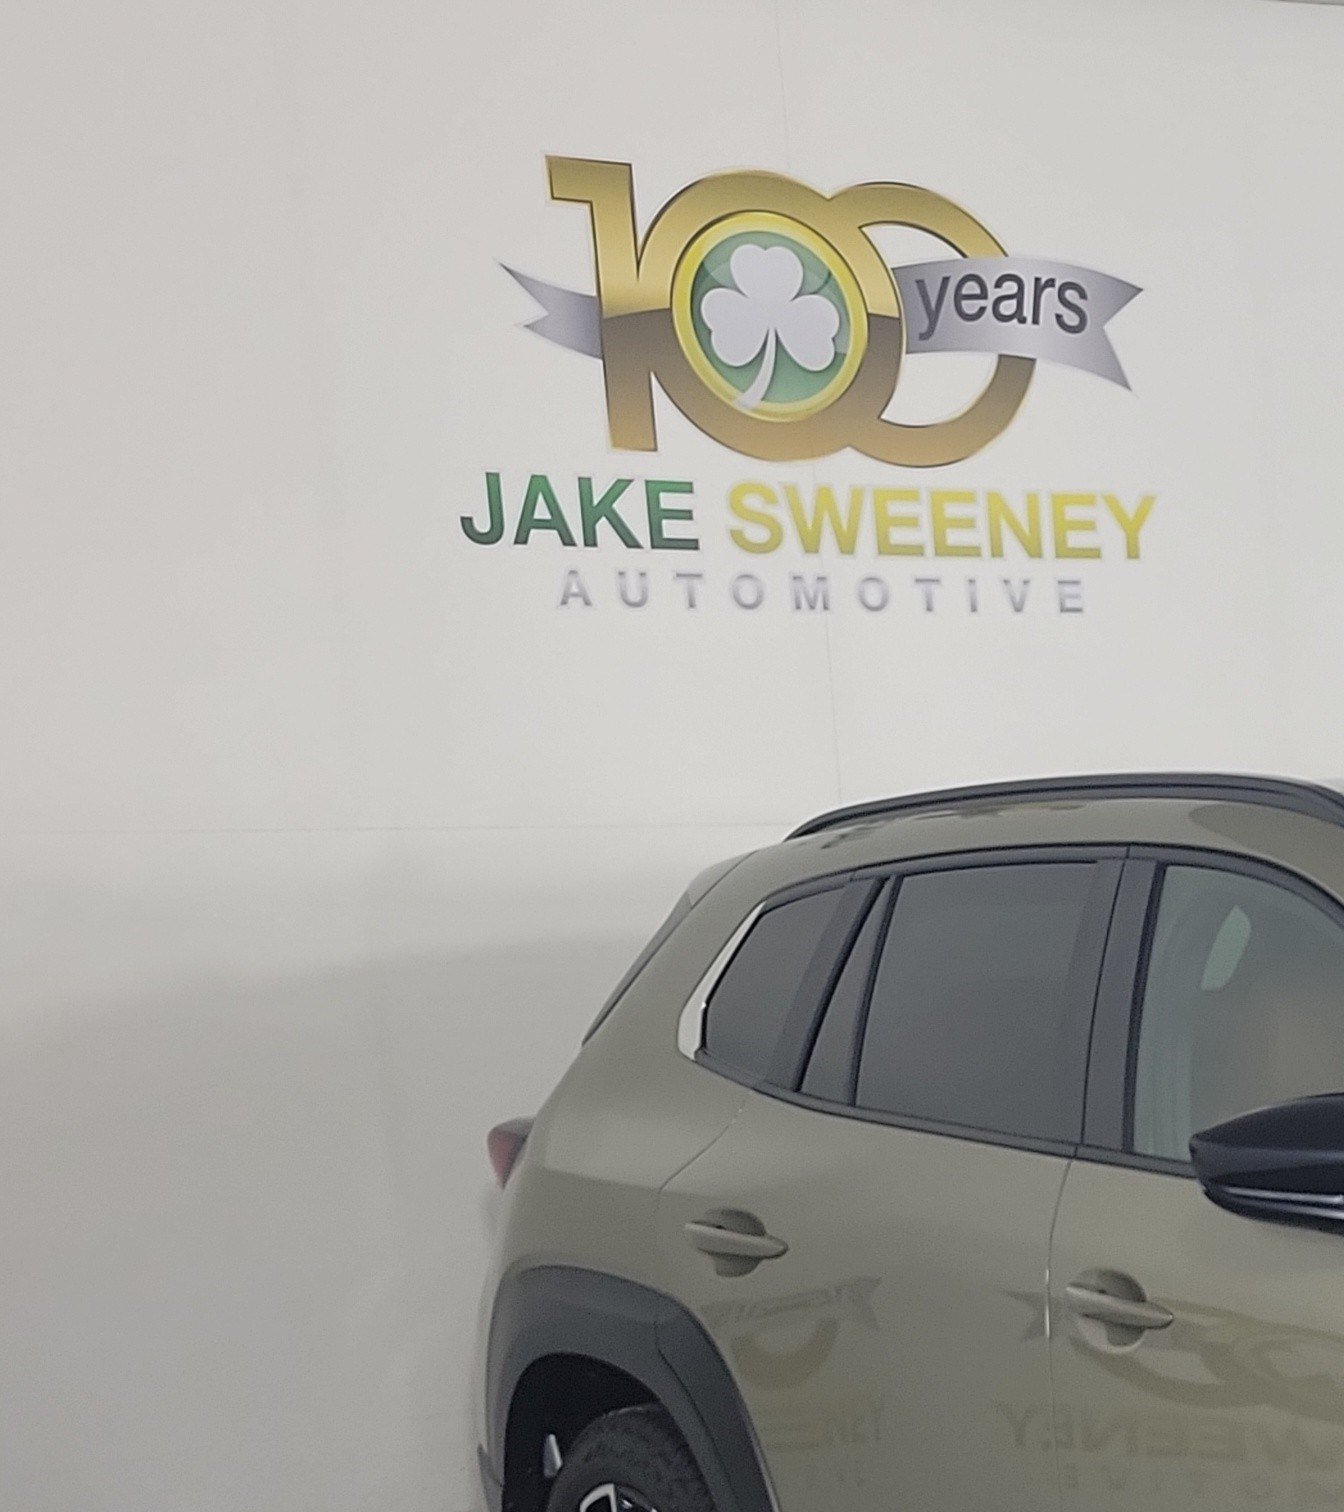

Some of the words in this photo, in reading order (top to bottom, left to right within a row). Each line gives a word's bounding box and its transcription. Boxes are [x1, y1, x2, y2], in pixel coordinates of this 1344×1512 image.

[914, 272, 1090, 341] years
[459, 471, 702, 551] JAKE
[727, 480, 1158, 562] SWEENEY
[558, 569, 1085, 614] AUTOMOTIVE
